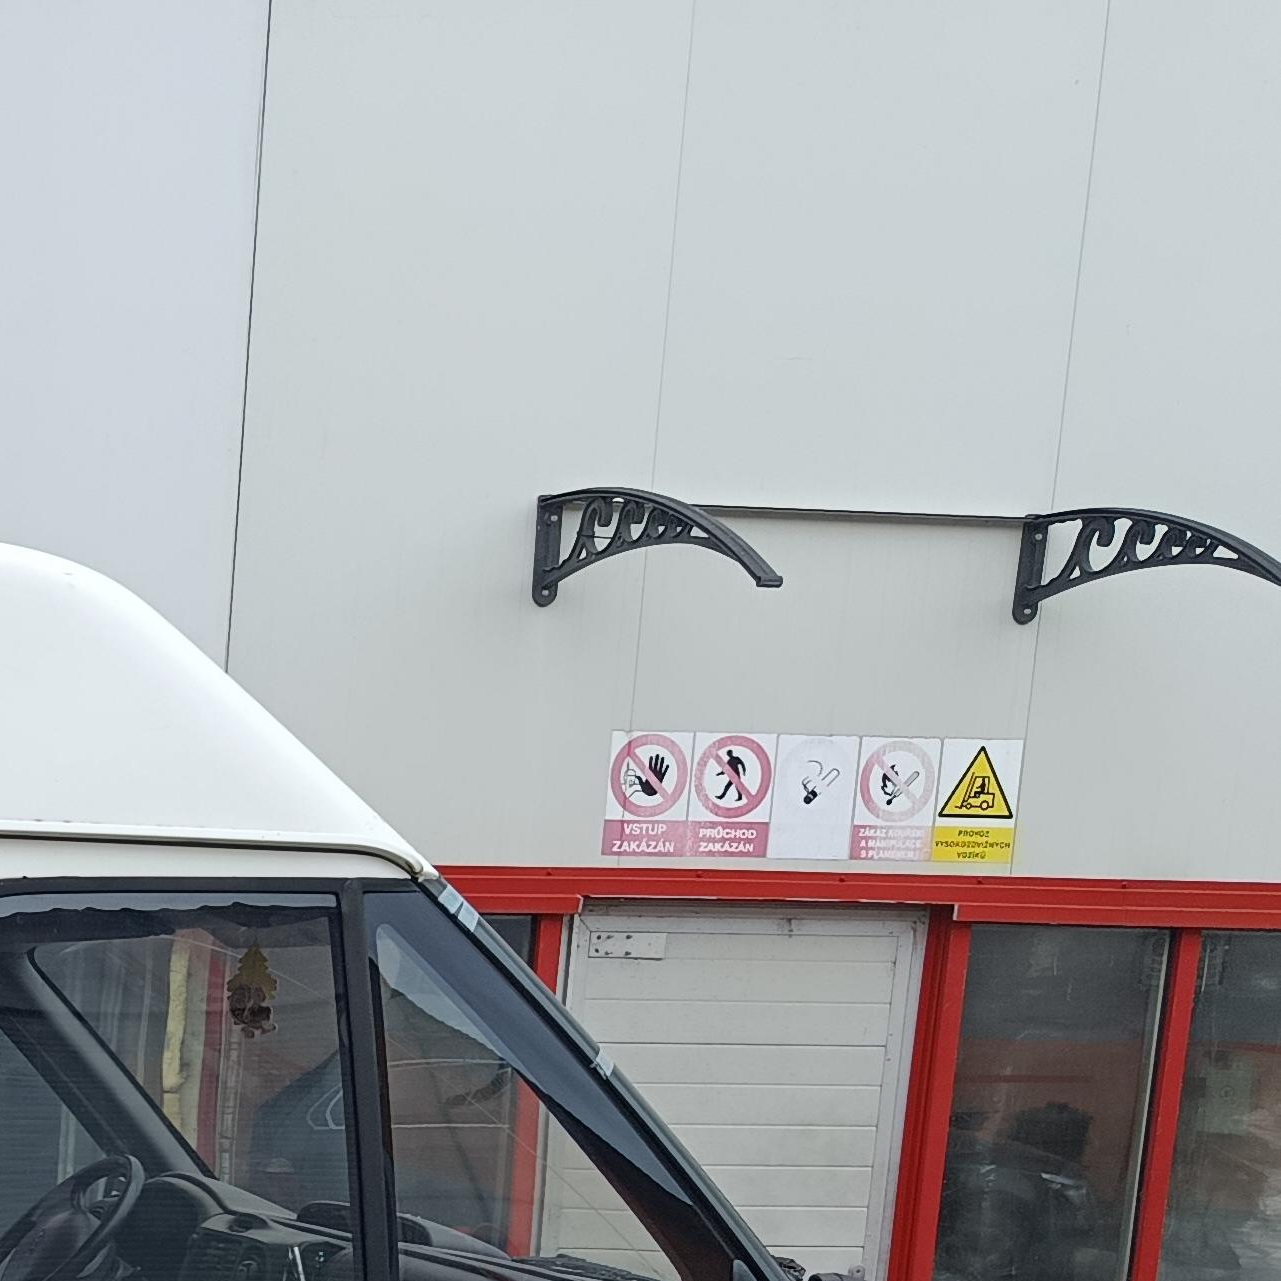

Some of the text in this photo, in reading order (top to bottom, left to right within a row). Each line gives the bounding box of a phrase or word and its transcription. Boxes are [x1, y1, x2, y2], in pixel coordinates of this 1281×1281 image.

[623, 823, 667, 835] VSTUP
[698, 826, 757, 839] PRŮCHOD
[612, 838, 675, 853] ZAKÁZÁN
[699, 840, 754, 853] ZAKÁZÁN
